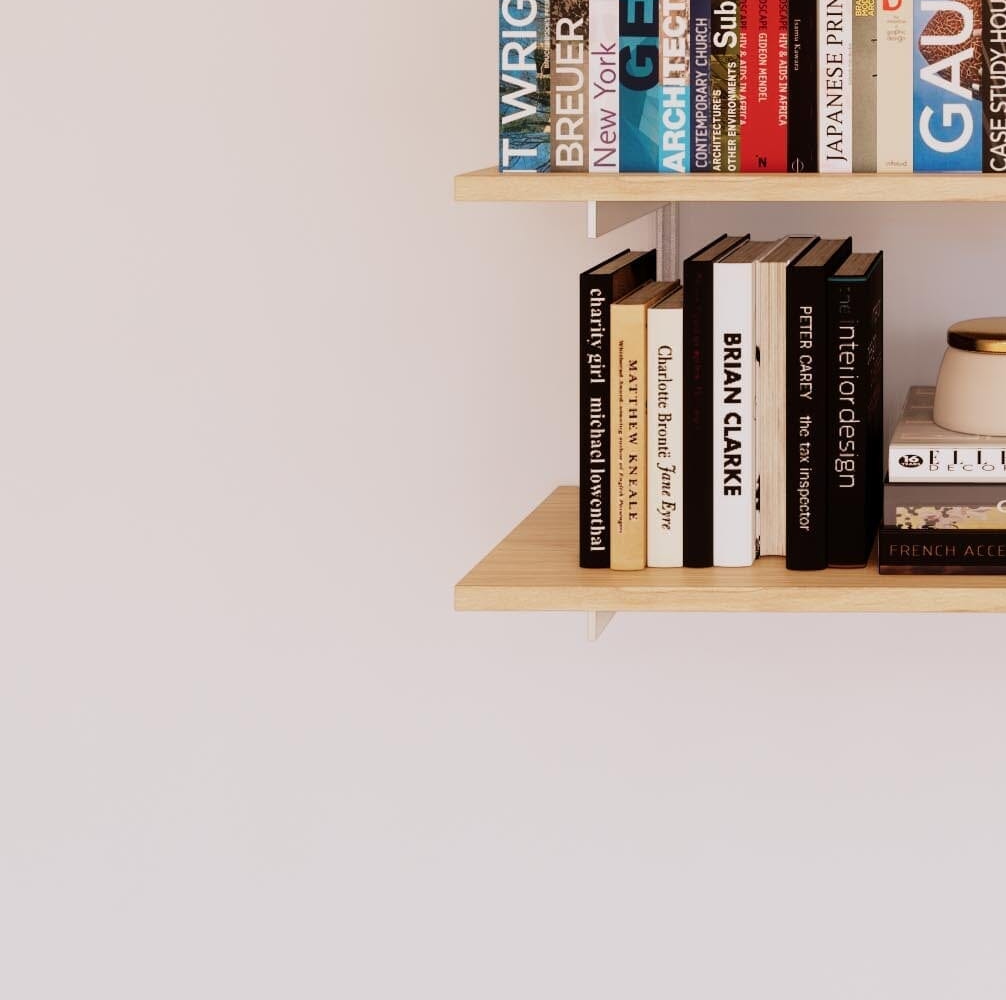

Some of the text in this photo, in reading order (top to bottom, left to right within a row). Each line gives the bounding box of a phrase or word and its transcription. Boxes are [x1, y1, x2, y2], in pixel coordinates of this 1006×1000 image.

[556, 17, 584, 166] BREUER
[695, 18, 708, 168] CONTEMPORARY CHURCH
[758, 33, 767, 66] GIDEON
[758, 68, 767, 102] MENDEL
[778, 32, 788, 49] HIV
[778, 60, 788, 80] AIDS
[778, 83, 788, 92] IN
[591, 42, 616, 167] New York
[712, 90, 722, 171] ARCHITECTURE'S
[727, 62, 737, 171] OTHER ENVIRONMENTS
[778, 95, 788, 126] AFRICA
[826, 53, 847, 162] JAPANESE
[587, 288, 606, 551] charity girl michael lowenthal
[628, 360, 637, 521] MATTHEW KNEALE
[656, 345, 677, 530] Charlotte Brontë Jane Eyre
[723, 333, 742, 496] BRIAN CLARKE
[794, 306, 812, 532] PETER CAREY the tax inspector
[903, 455, 920, 464] 16
[889, 544, 956, 558] FRENCH
